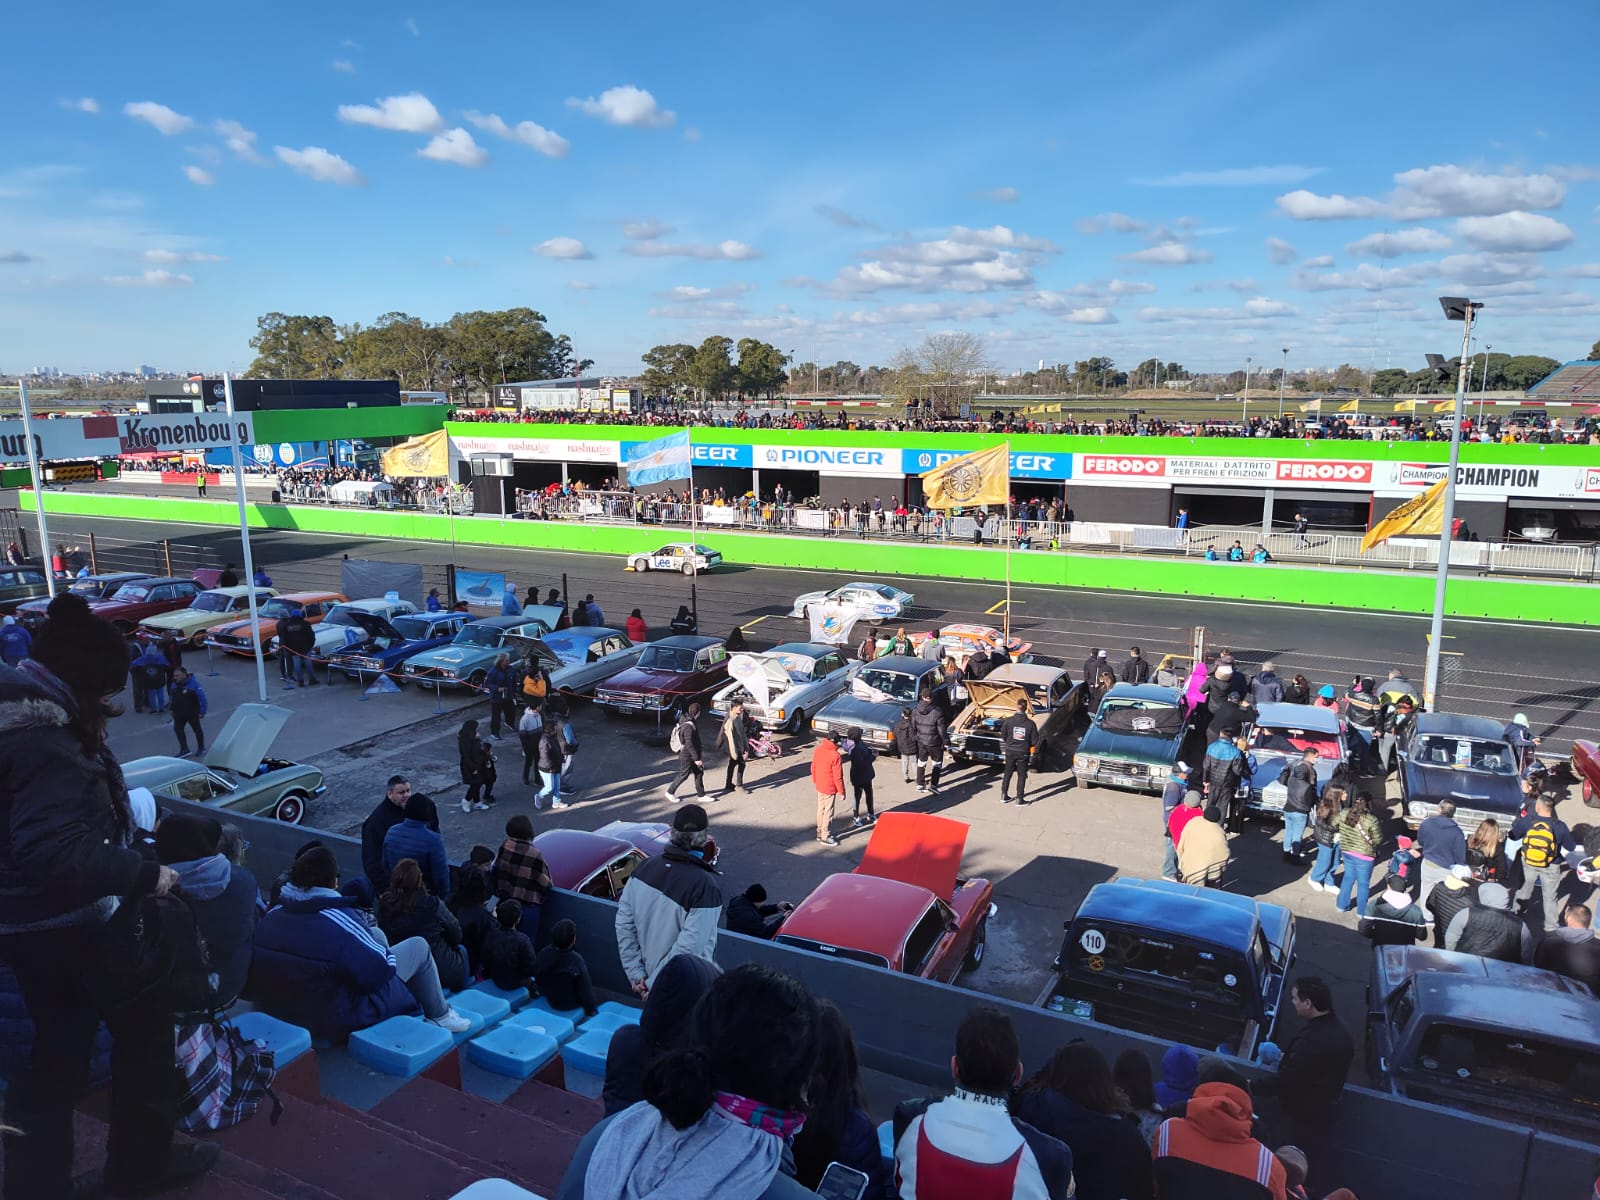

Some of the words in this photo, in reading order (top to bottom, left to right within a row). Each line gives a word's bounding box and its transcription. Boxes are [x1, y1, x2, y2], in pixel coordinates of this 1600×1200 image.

[124, 416, 249, 449] Kronenboug
[782, 449, 884, 465] PIONEER
[1170, 460, 1218, 468] MATERIALI
[1085, 458, 1160, 474] FERODO
[1192, 468, 1218, 476] FRENI
[1220, 469, 1226, 477] E
[1228, 469, 1268, 478] FRIZIONI
[1279, 463, 1366, 480] FERODO
[1402, 470, 1448, 480] CHAMPION
[1455, 467, 1540, 488] CHAMPION
[1085, 933, 1101, 950] 110
